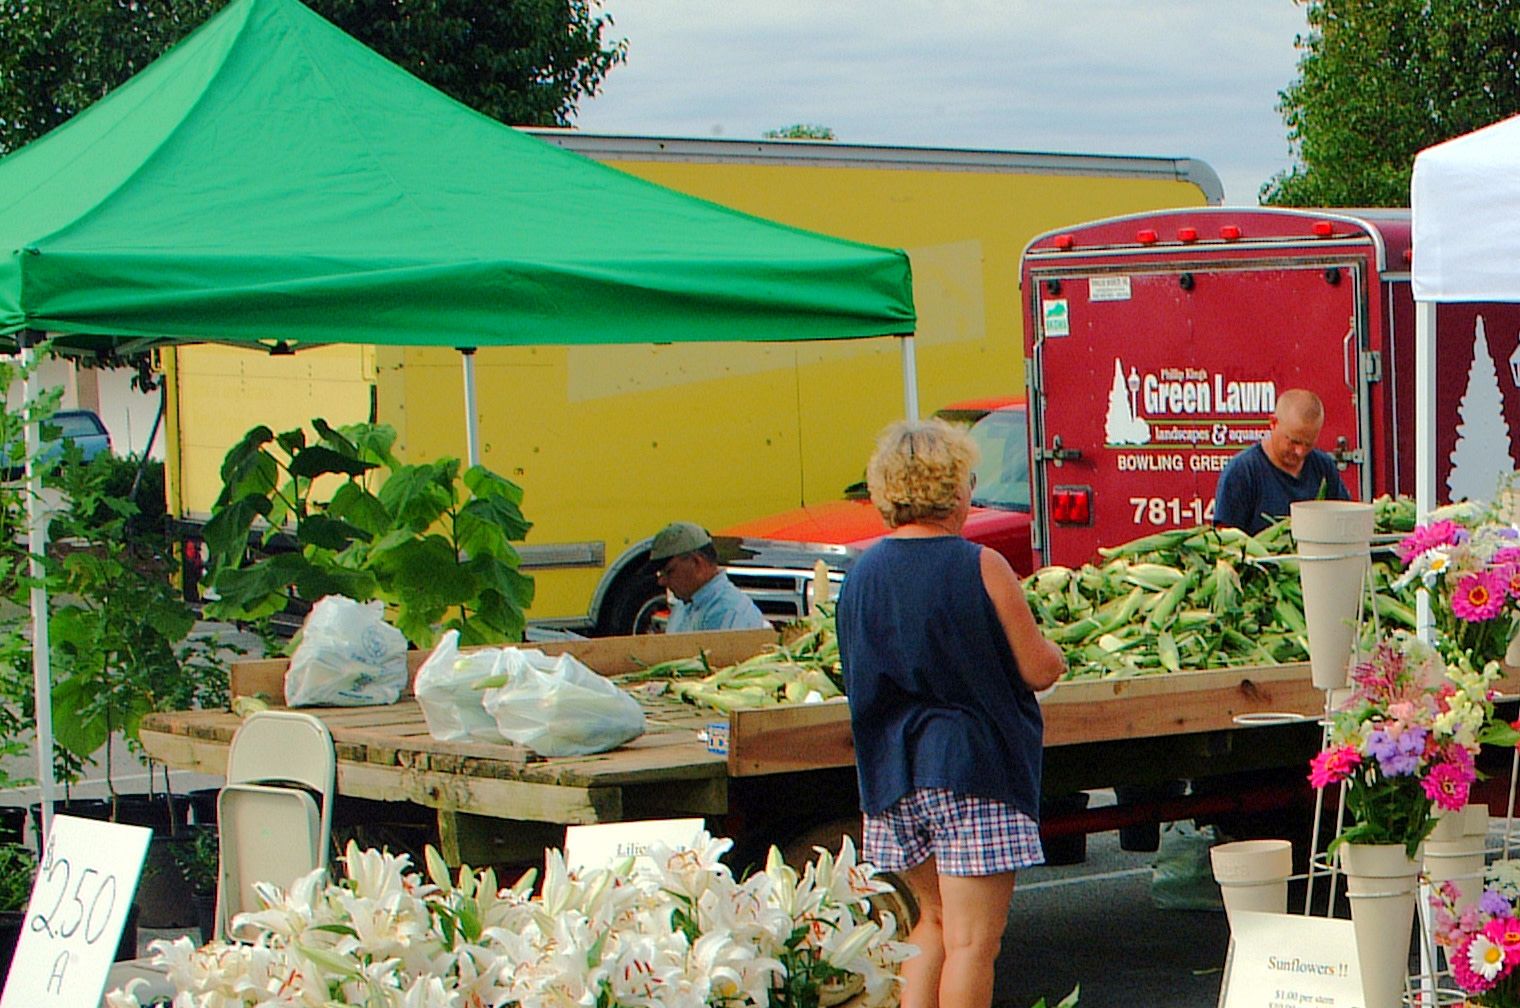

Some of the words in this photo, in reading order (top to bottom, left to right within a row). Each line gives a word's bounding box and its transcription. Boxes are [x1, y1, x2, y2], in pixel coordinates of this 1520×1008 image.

[1143, 373, 1210, 413] Green
[1215, 373, 1276, 413] Lawn
[1212, 424, 1227, 445] &
[1117, 454, 1184, 471] BOWLING
[1189, 454, 1235, 471] GREE
[47, 950, 70, 995] A
[1268, 956, 1335, 975] Sunflowers
